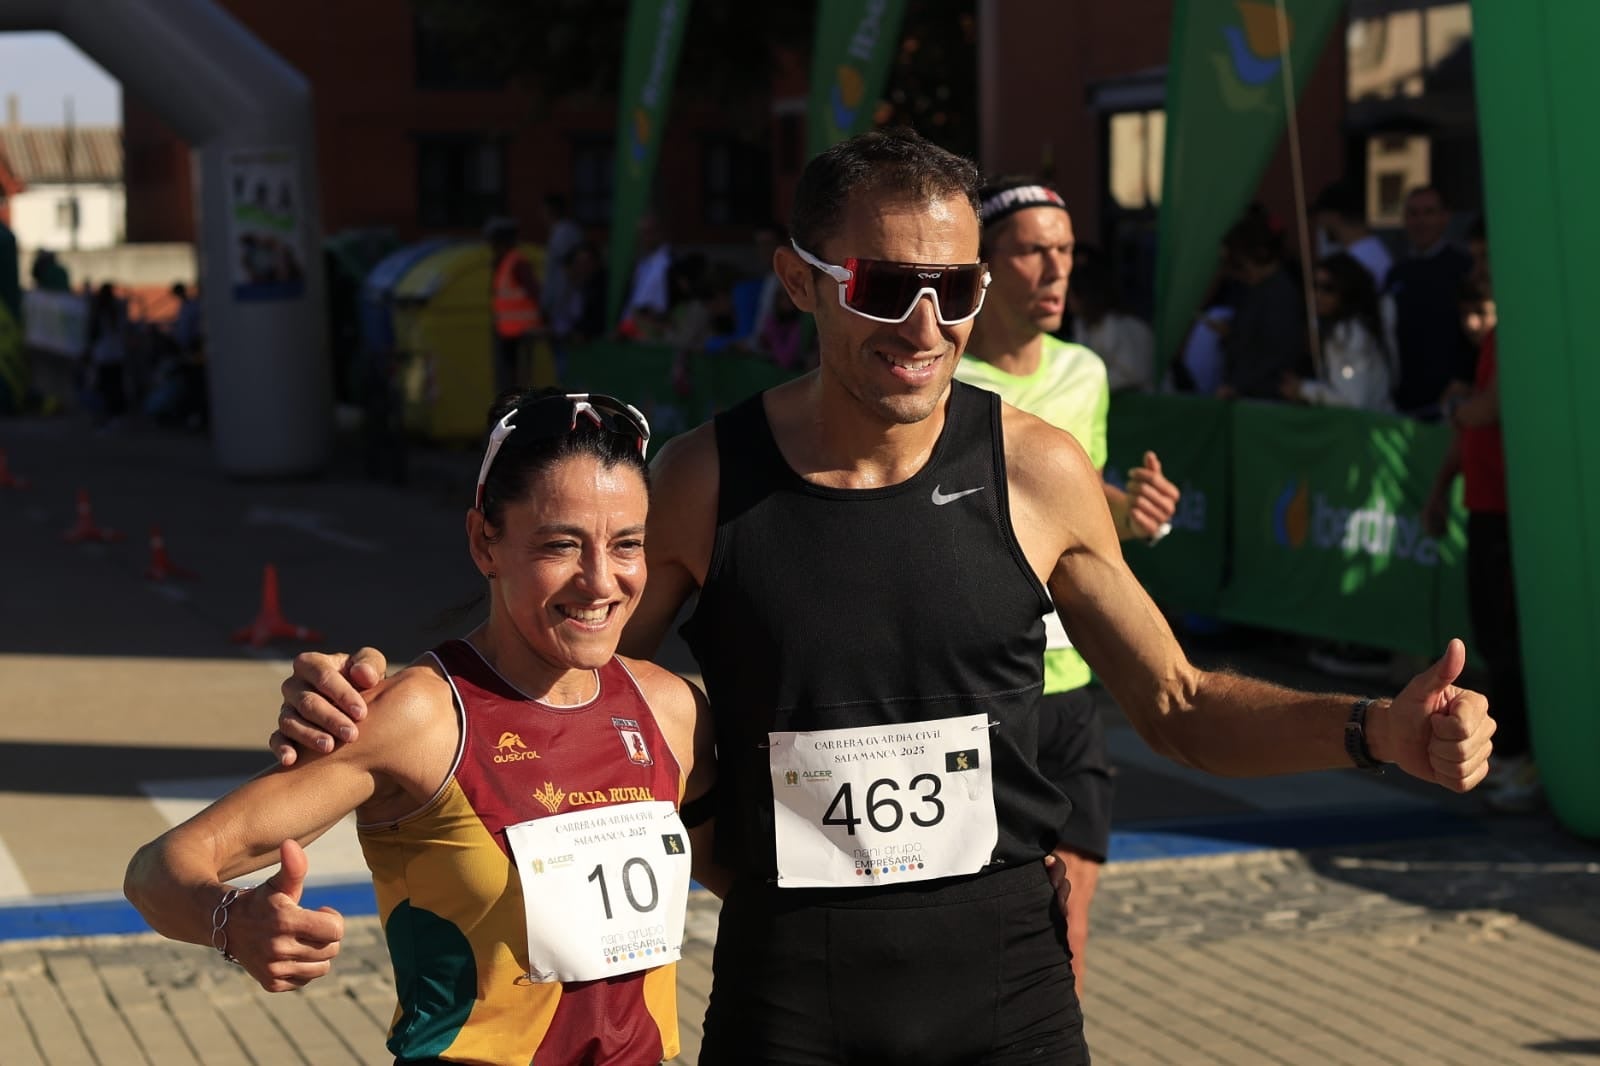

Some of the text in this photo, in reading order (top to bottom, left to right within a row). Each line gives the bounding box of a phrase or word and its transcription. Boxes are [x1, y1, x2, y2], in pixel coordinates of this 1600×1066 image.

[814, 734, 864, 751] CARRERA
[834, 745, 926, 764] SALAMANCA 2025
[568, 786, 655, 806] CAJA RURAL
[822, 773, 945, 836] 463
[854, 841, 922, 859] nani grupo
[854, 853, 924, 869] EMPRESARIAL
[587, 857, 659, 920] 10
[627, 924, 665, 943] grupo
[603, 936, 666, 957] EMPRESARIAL
